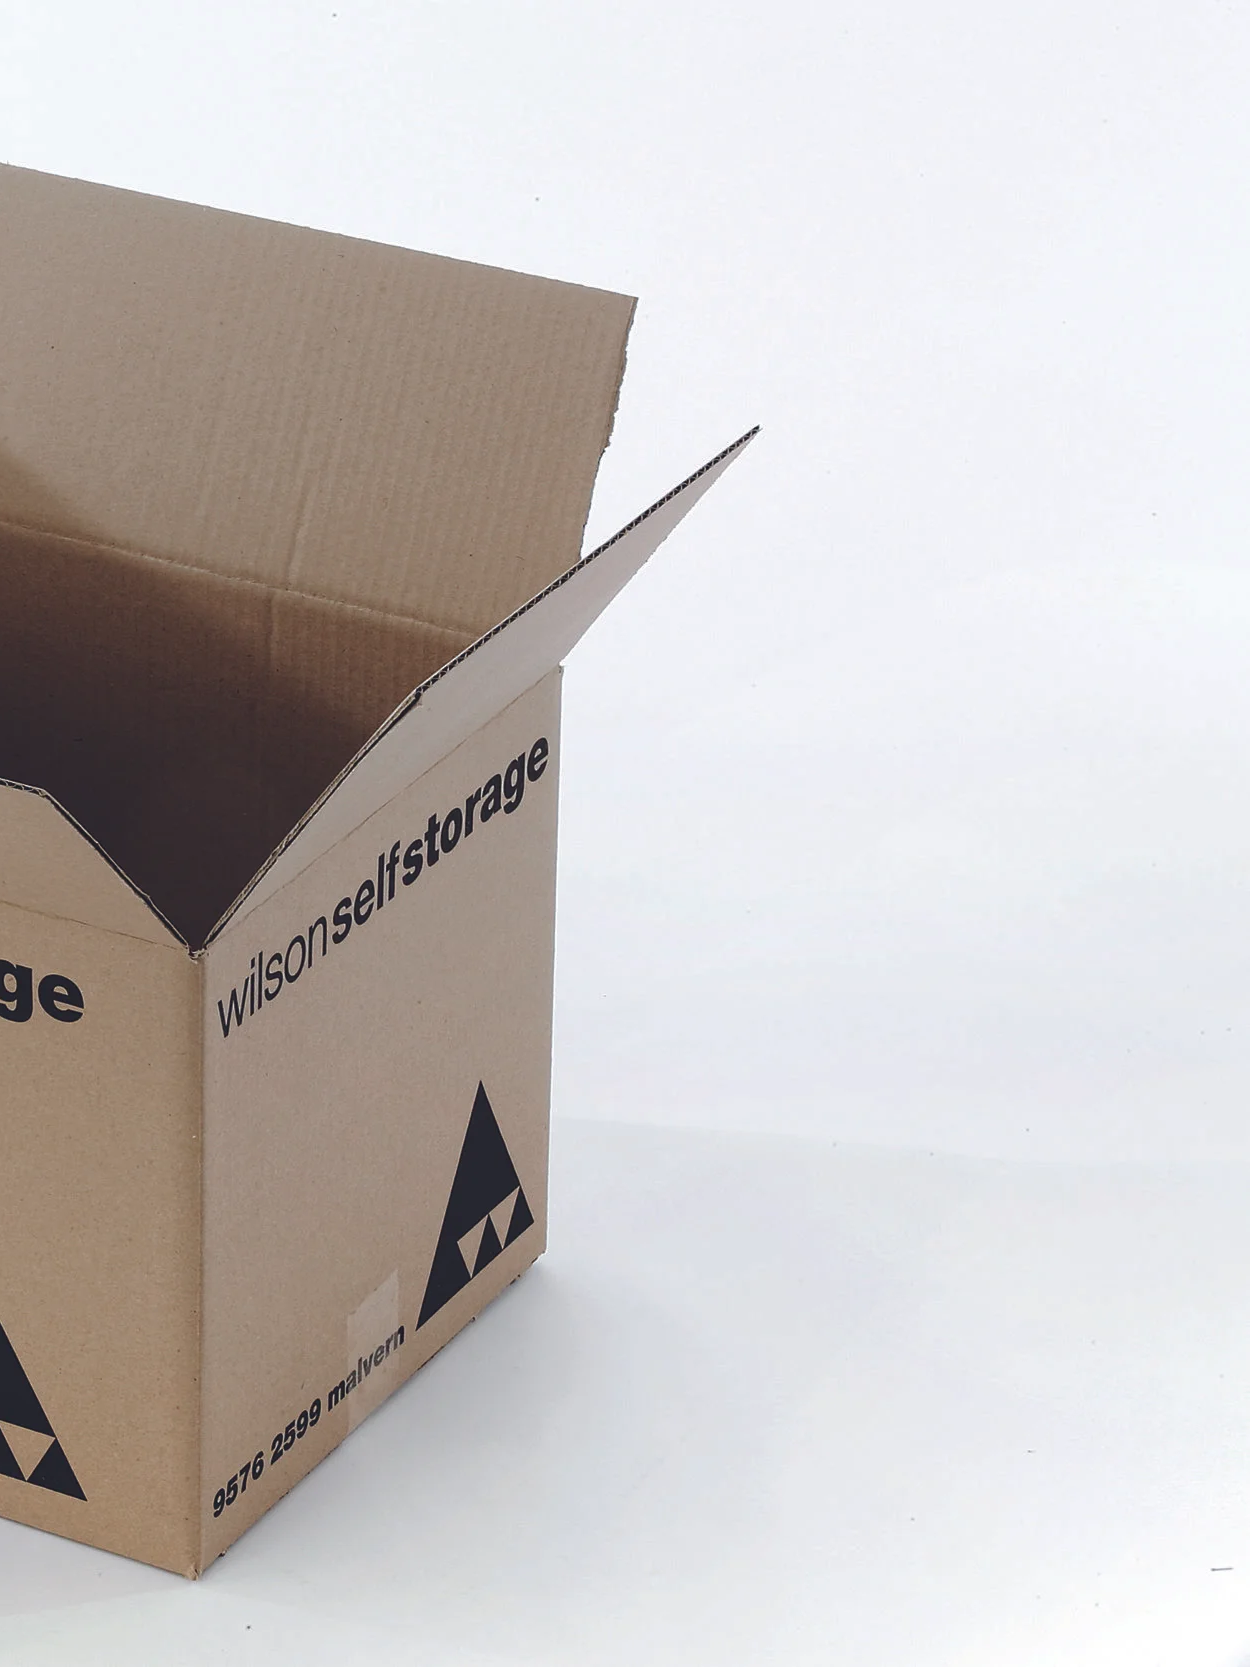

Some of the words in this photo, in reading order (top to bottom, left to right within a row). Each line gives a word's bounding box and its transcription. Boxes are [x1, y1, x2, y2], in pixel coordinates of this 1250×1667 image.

[213, 1450, 265, 1518] 9576
[270, 1397, 322, 1466] 2599
[327, 1324, 405, 1413] malvern
